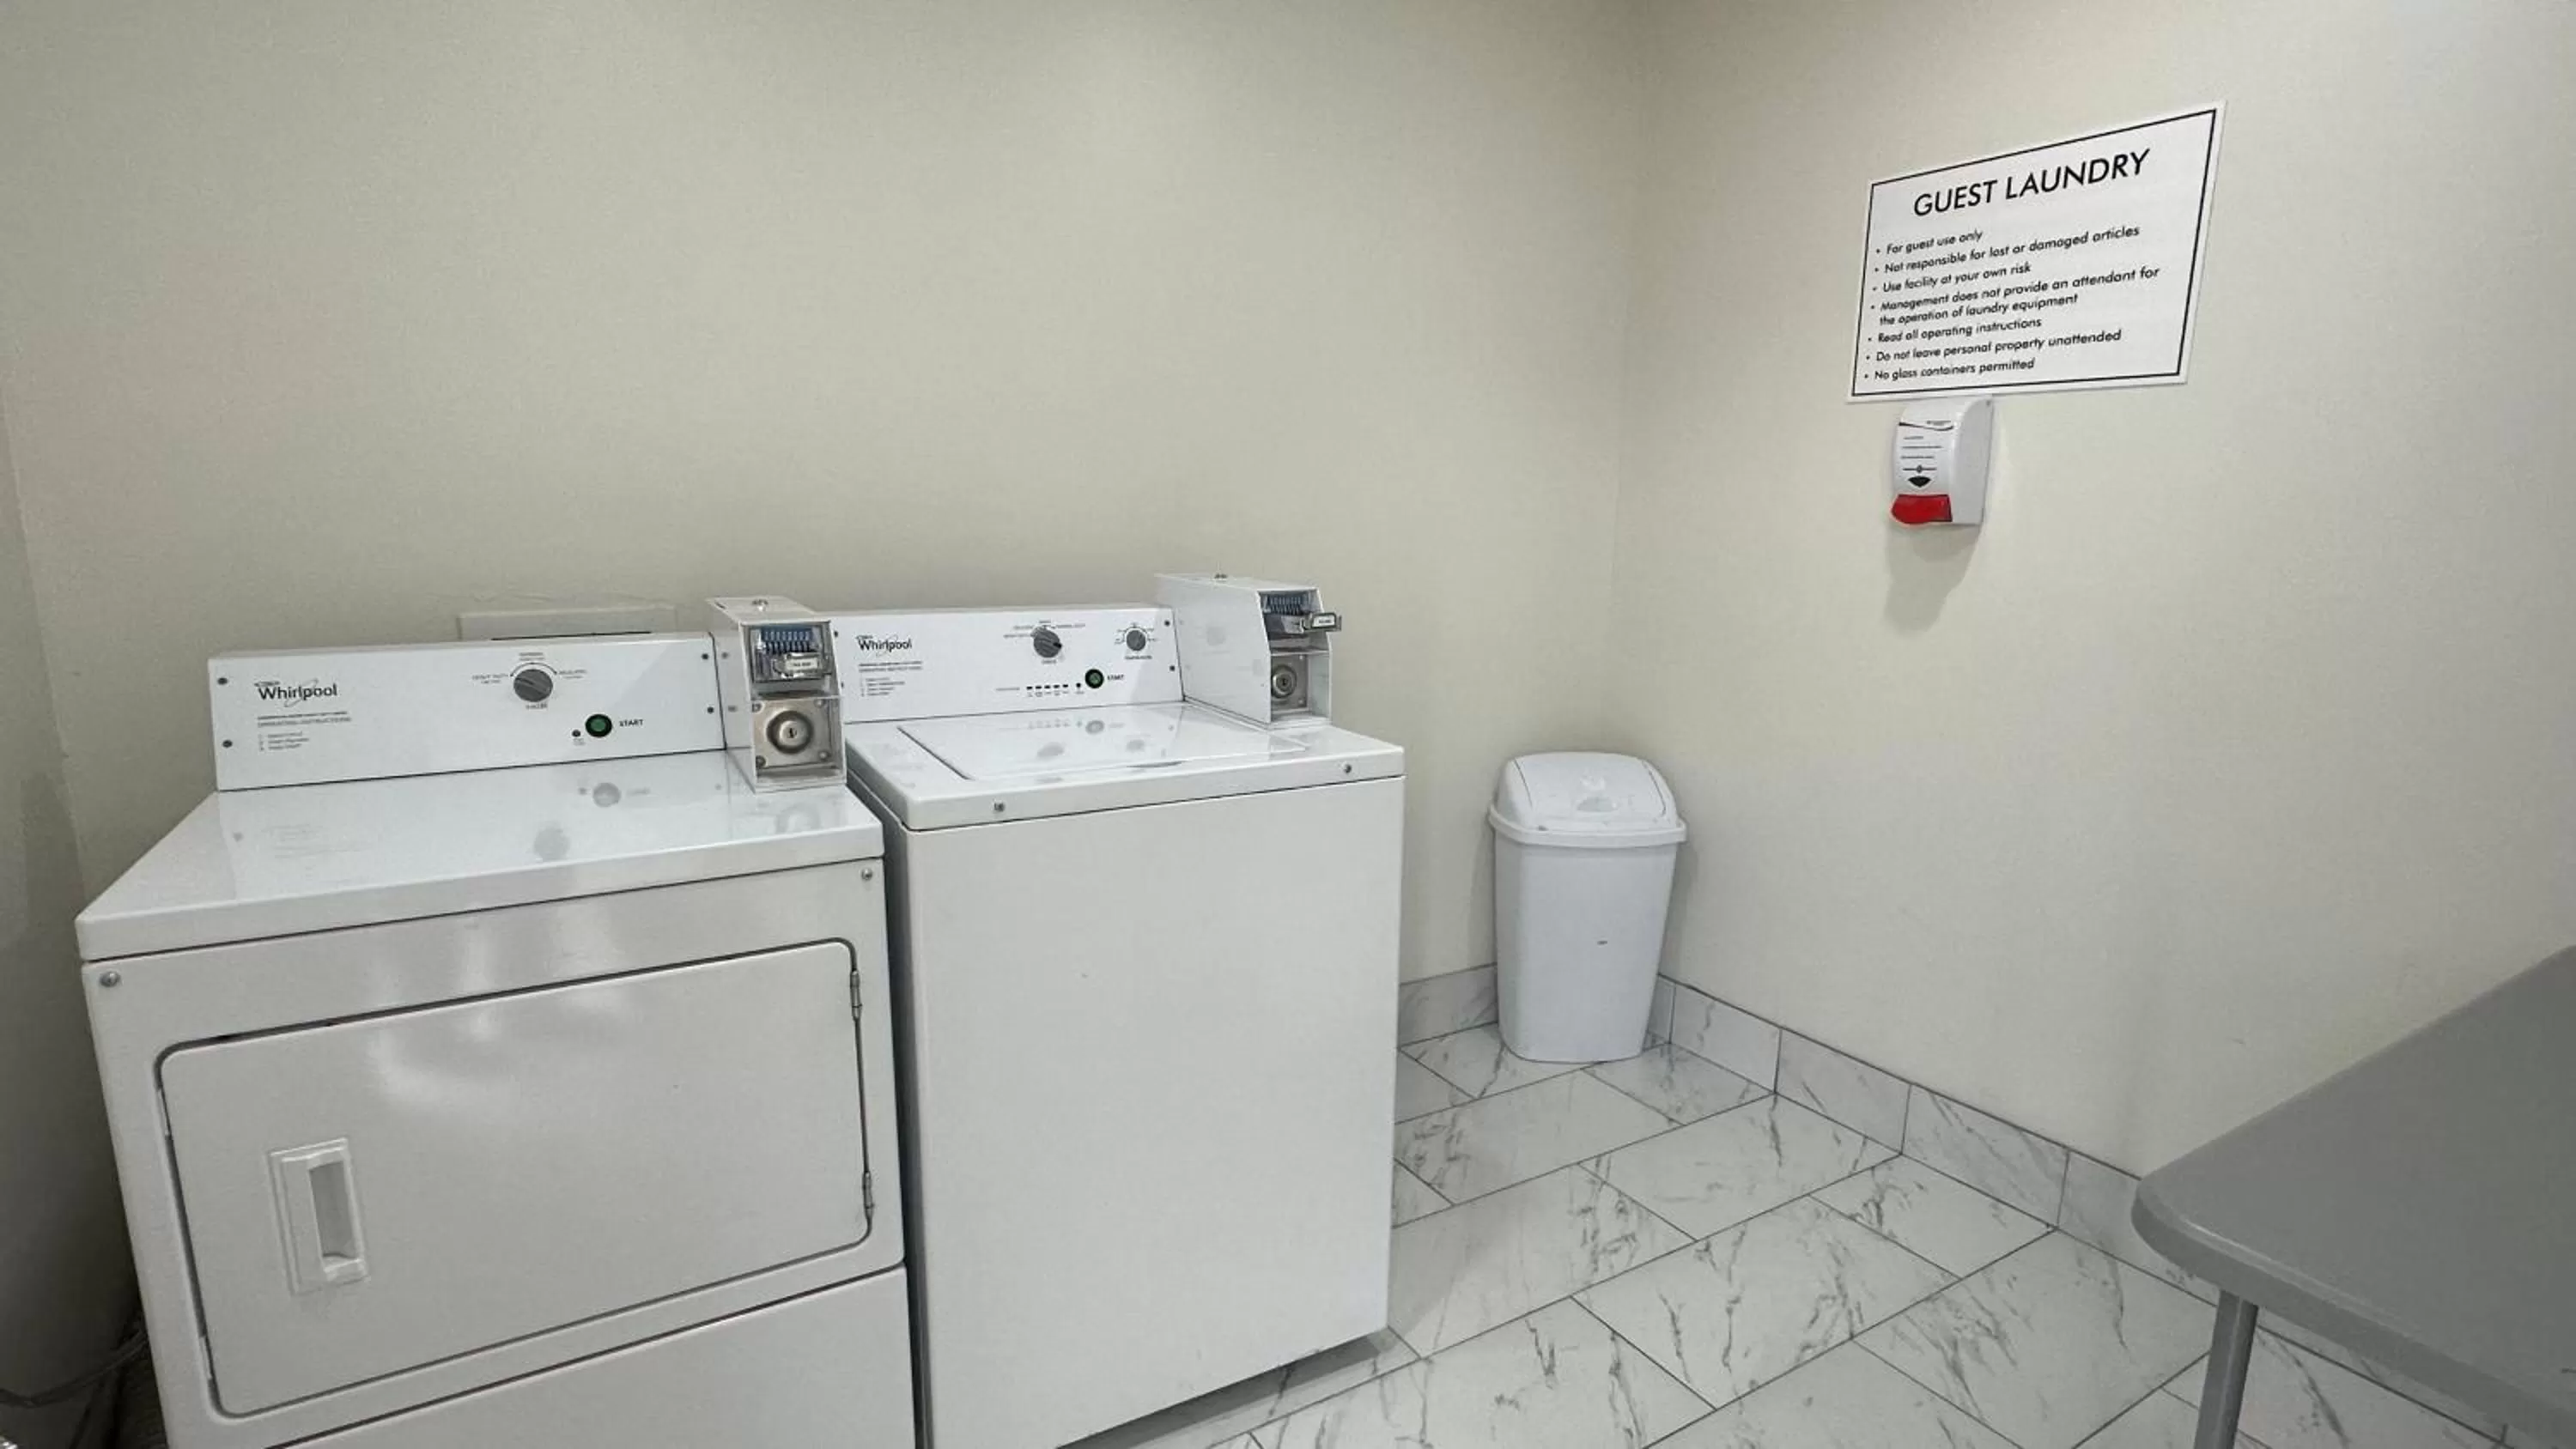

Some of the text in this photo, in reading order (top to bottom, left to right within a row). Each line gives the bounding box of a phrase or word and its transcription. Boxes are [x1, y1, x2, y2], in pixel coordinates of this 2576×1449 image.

[1914, 148, 2150, 216] GUEST LAUNDRY
[1885, 225, 2140, 273] Not responsible for lost or damaged articles
[1886, 228, 1983, 255] For guest use only
[1880, 266, 2160, 312] Management does not provide an attendant for
[1883, 261, 2031, 293] Use facility at your own risk
[1880, 294, 2078, 325] the operation of laundry equipment
[1878, 317, 2042, 343] Read all operating instructions
[1876, 329, 2122, 361] Do not leave personal property unattended
[1874, 356, 2036, 381] No glass containers permitted
[859, 638, 912, 652] Whirlpool
[258, 682, 337, 701] Whirlpool
[619, 718, 644, 728] START
